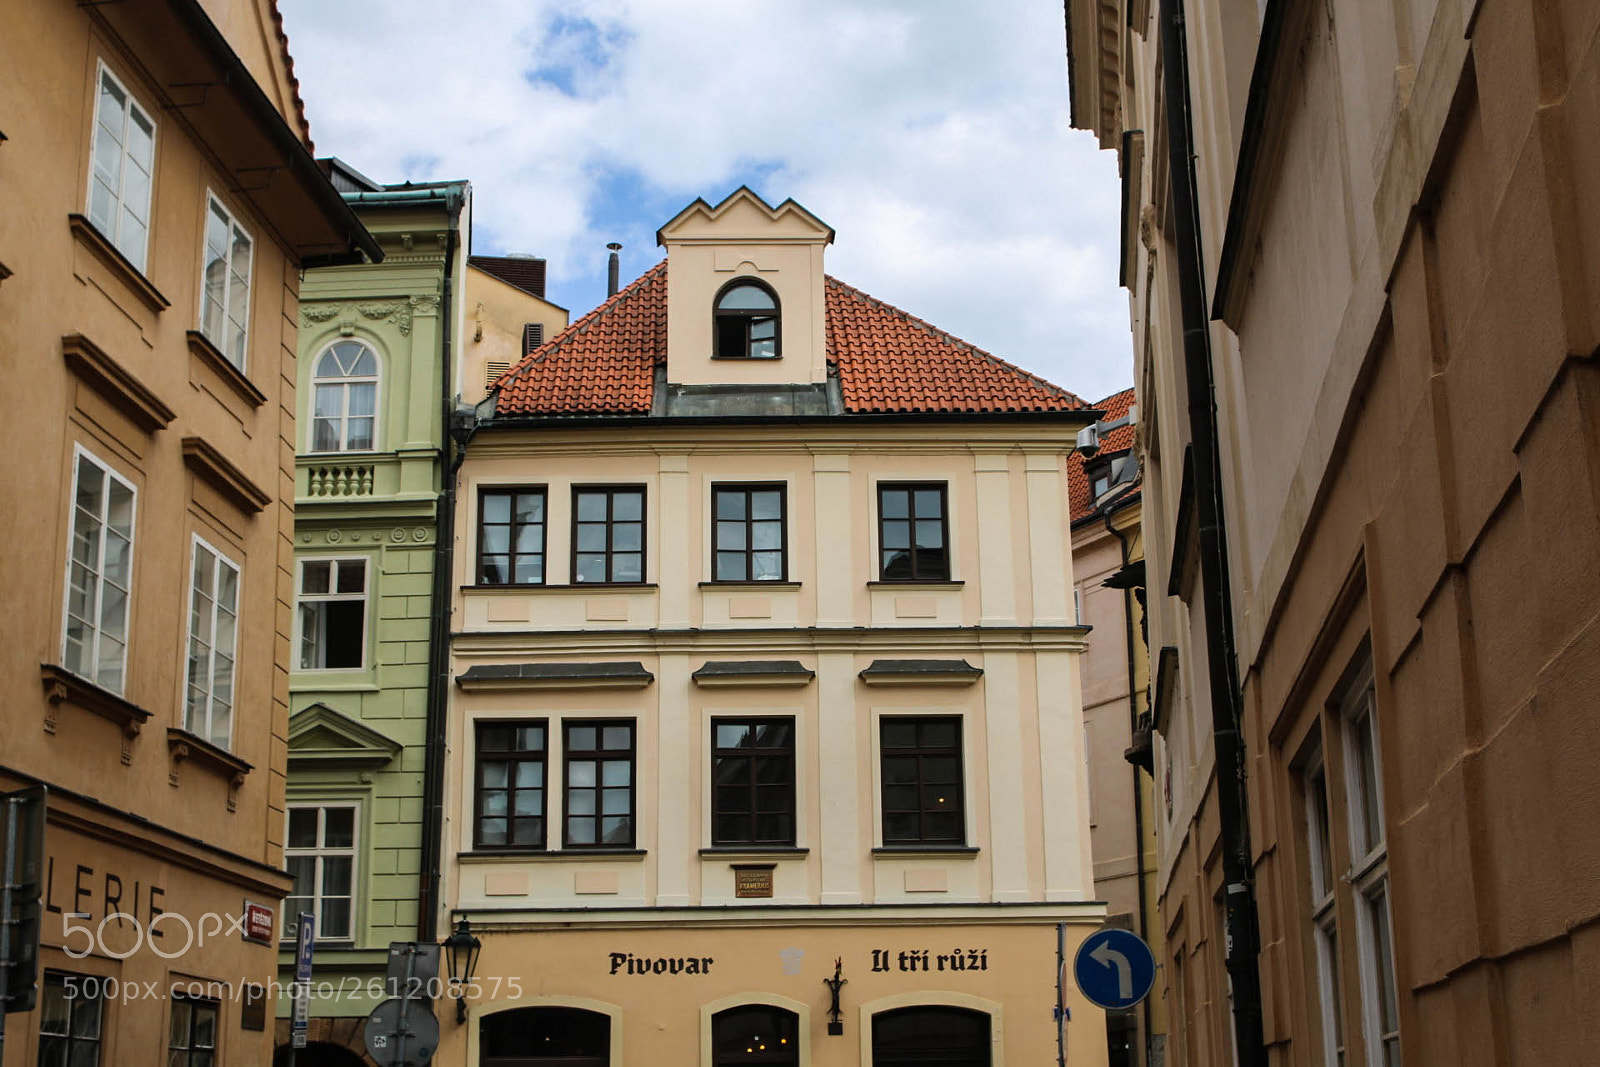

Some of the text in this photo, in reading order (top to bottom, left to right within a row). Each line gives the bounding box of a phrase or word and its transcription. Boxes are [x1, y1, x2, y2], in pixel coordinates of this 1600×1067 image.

[609, 952, 714, 975] Pivovar
[898, 949, 929, 972] tří
[937, 948, 988, 971] růží
